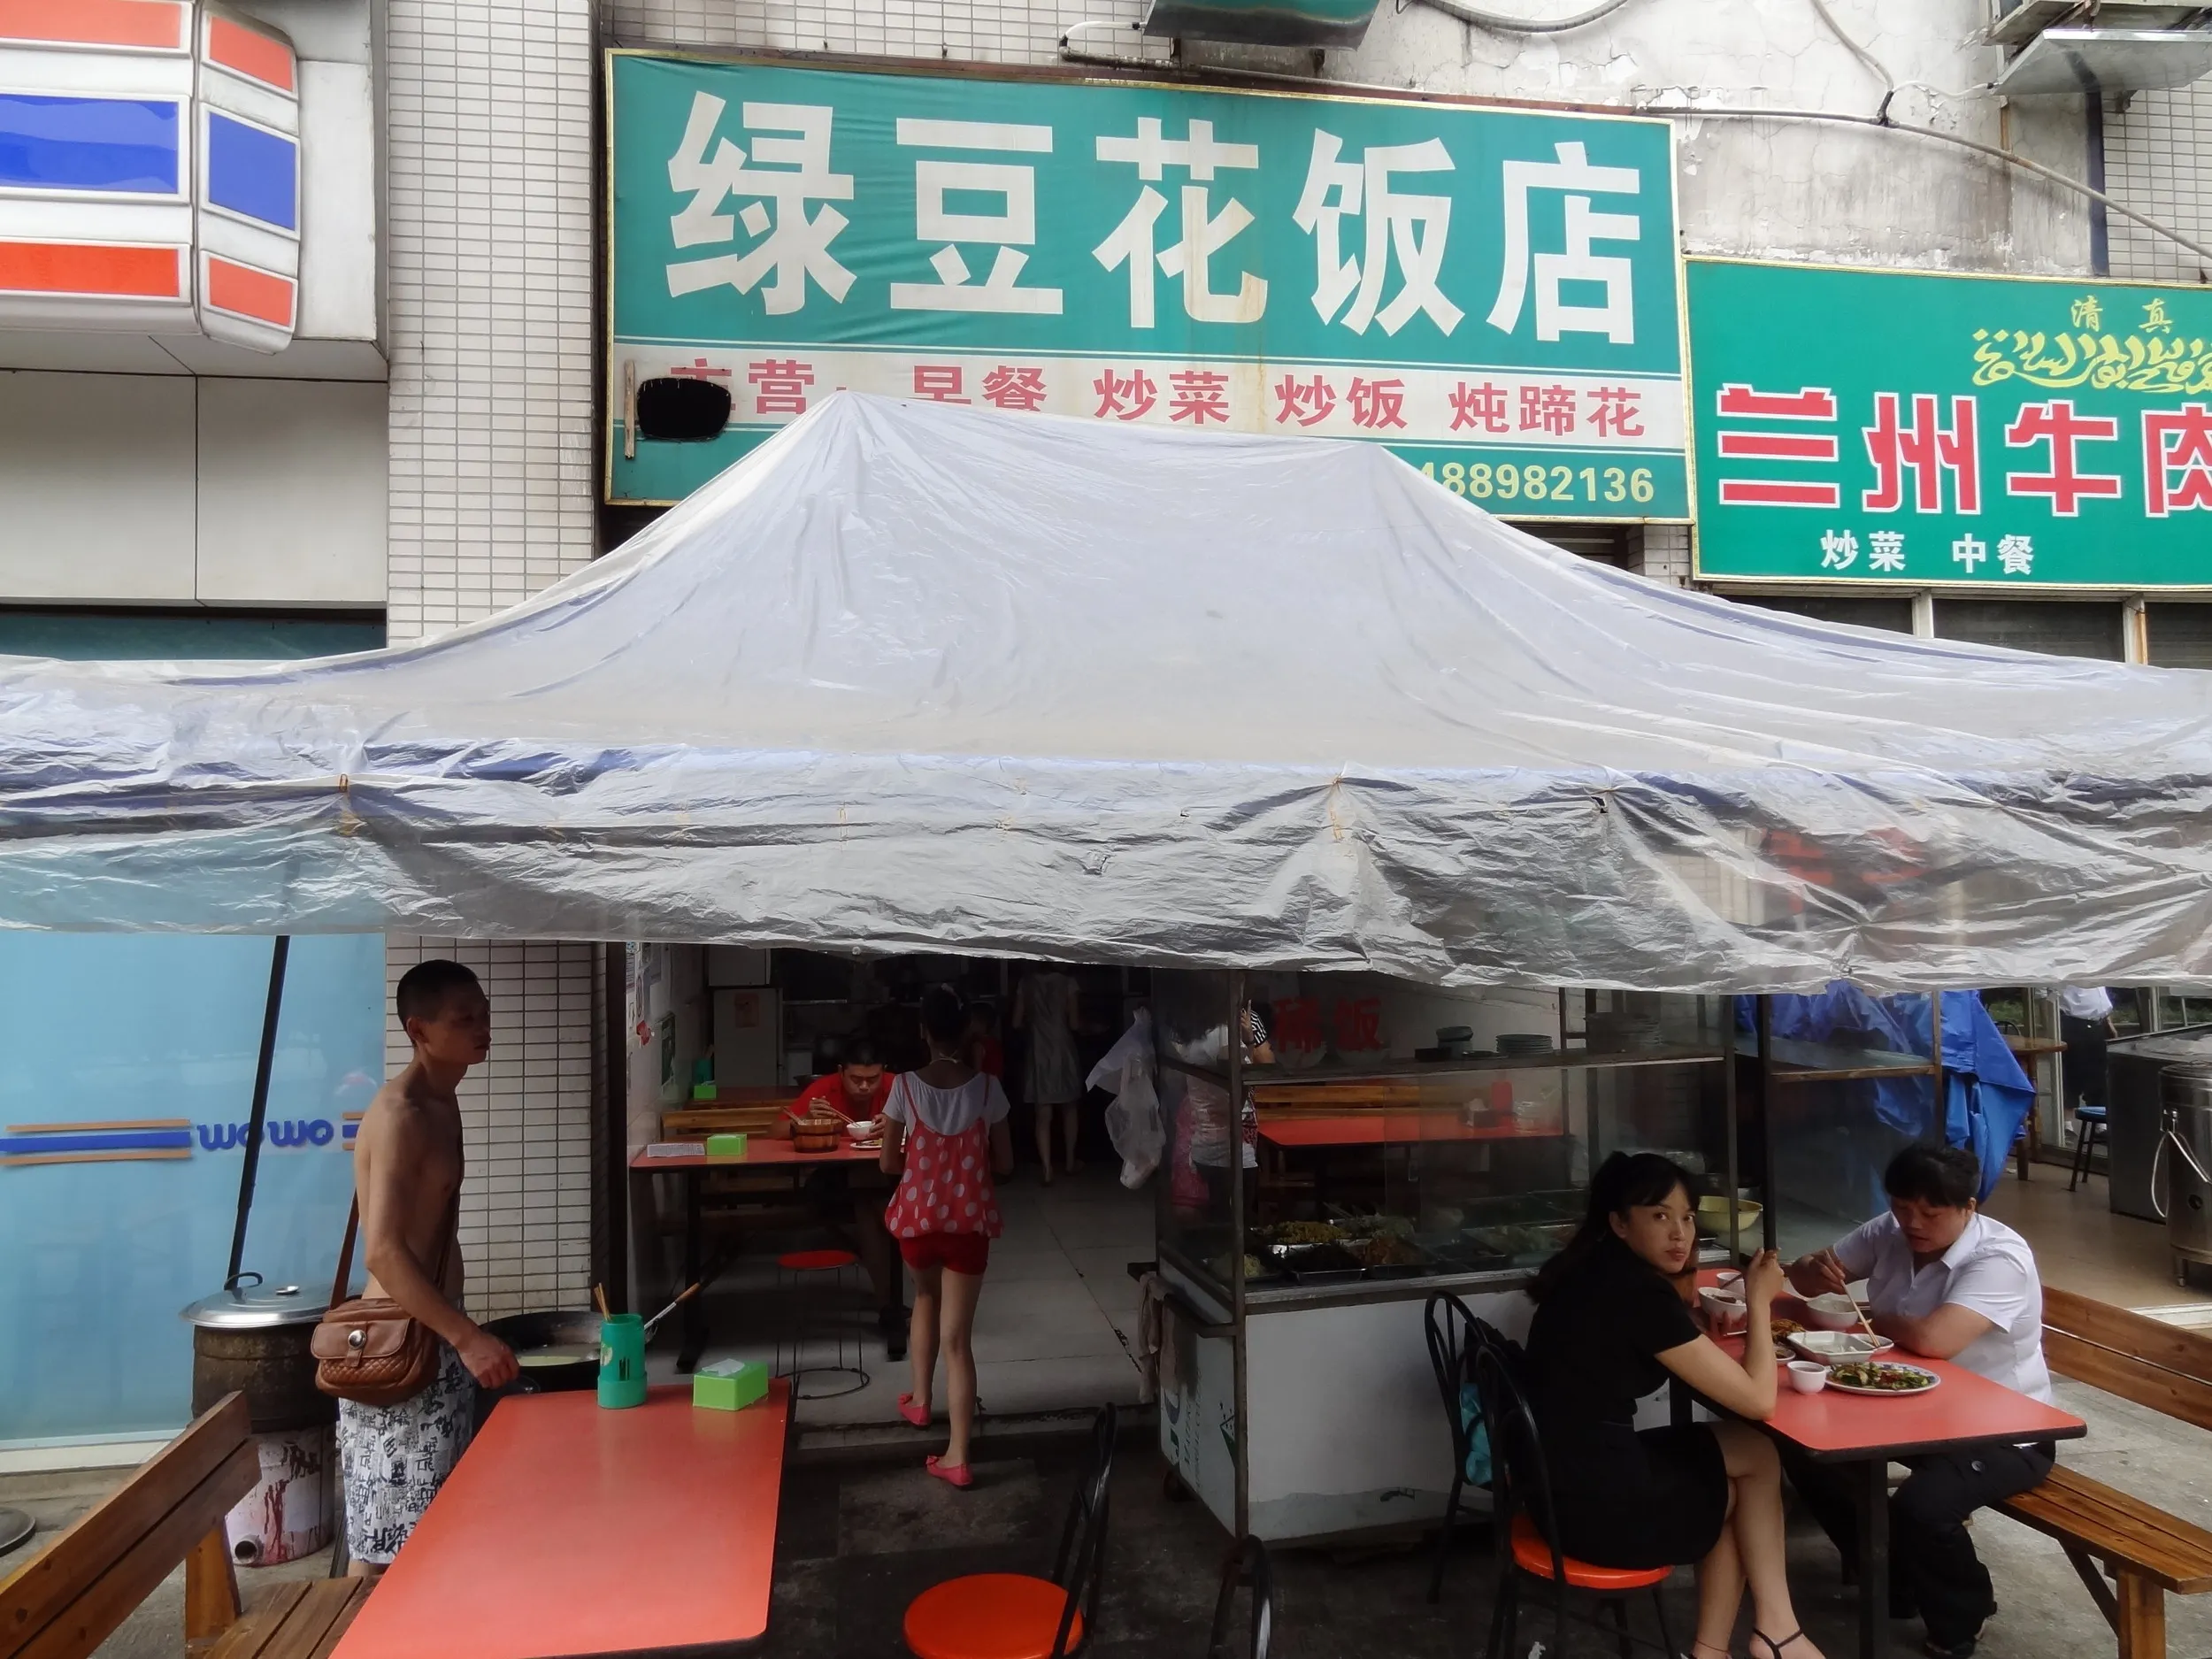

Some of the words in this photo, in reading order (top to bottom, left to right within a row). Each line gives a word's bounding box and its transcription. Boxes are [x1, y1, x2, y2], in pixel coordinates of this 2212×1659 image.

[666, 90, 1640, 344] 绿豆花饭店
[2070, 295, 2173, 334] 清真
[913, 365, 1048, 412] 早餐
[1093, 368, 1231, 425] 炒菜
[1274, 373, 1409, 430] 炒饭
[1448, 381, 1646, 438] 炖蹄花
[1717, 383, 2212, 518] 兰州牛肉
[1820, 528, 1907, 572] 炒菜
[1952, 533, 2034, 575] 中餐
